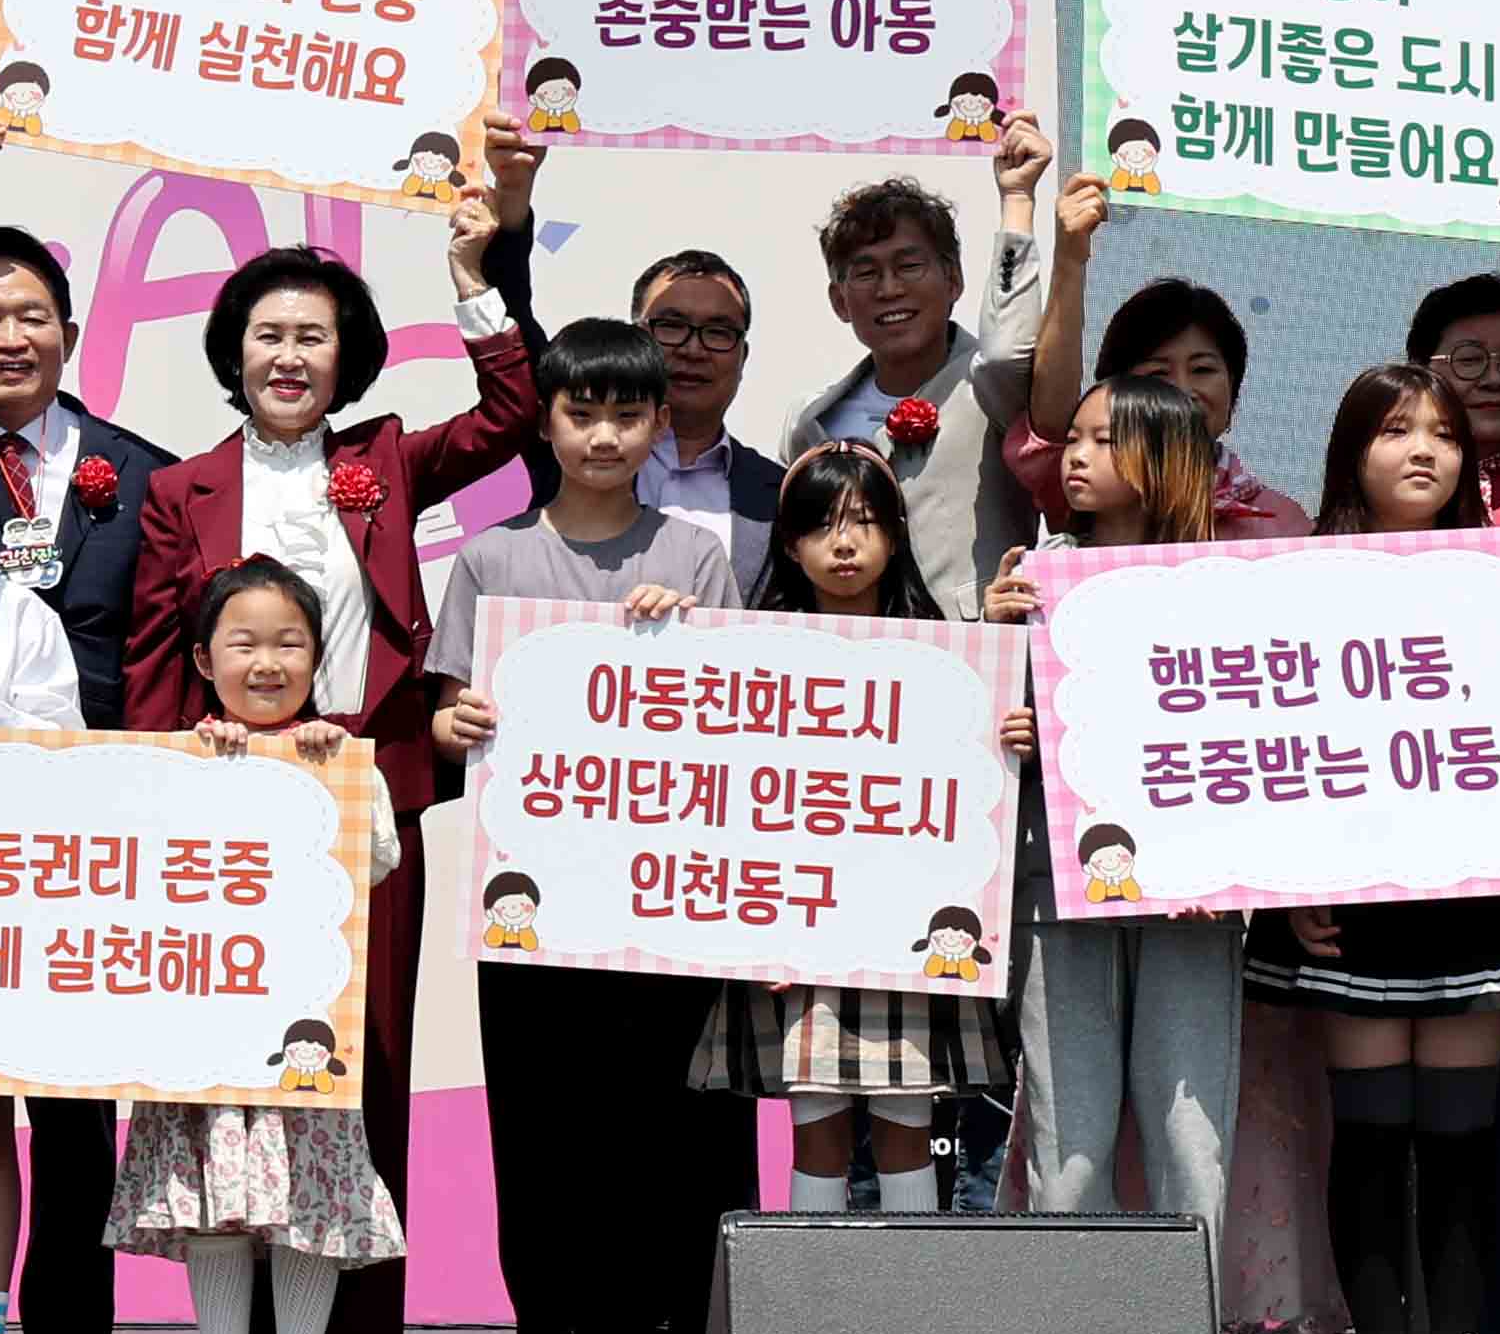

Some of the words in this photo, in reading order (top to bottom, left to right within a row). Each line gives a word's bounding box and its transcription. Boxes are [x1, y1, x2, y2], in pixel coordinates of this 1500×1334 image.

[199, 22, 405, 105] 실천해요
[1174, 11, 1378, 89] 살기좋은
[1397, 36, 1494, 102] 도시
[1171, 93, 1273, 166] 함께
[1295, 111, 1498, 186] 만들어요
[588, 664, 901, 744] 아동친화도시
[1149, 638, 1320, 713] 행복한
[1341, 636, 1470, 701] 아동,
[521, 754, 728, 827] 상위단계
[751, 766, 957, 842] 인증도시
[1142, 735, 1369, 808] 존중받는
[1390, 727, 1500, 792] 아동
[161, 839, 272, 905] 존중
[631, 851, 837, 927] 인천동구
[45, 924, 268, 996] 실천해요
